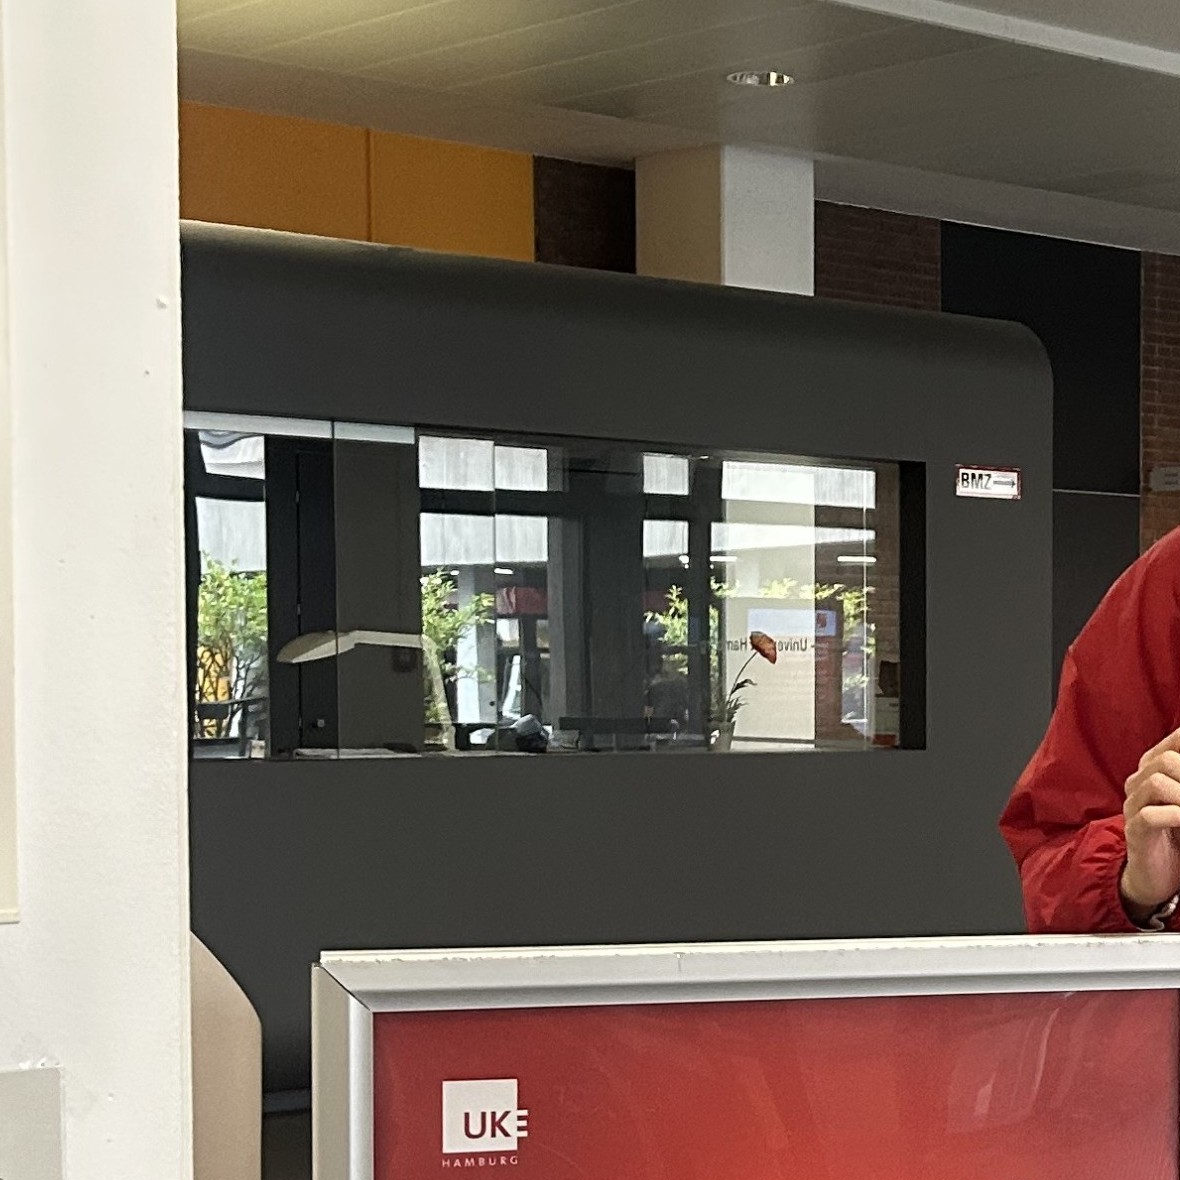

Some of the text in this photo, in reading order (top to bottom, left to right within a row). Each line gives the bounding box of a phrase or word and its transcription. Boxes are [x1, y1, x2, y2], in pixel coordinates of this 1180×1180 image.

[961, 472, 992, 490] BMZ
[464, 1109, 529, 1139] UKE
[442, 1156, 518, 1168] HAMBURG
